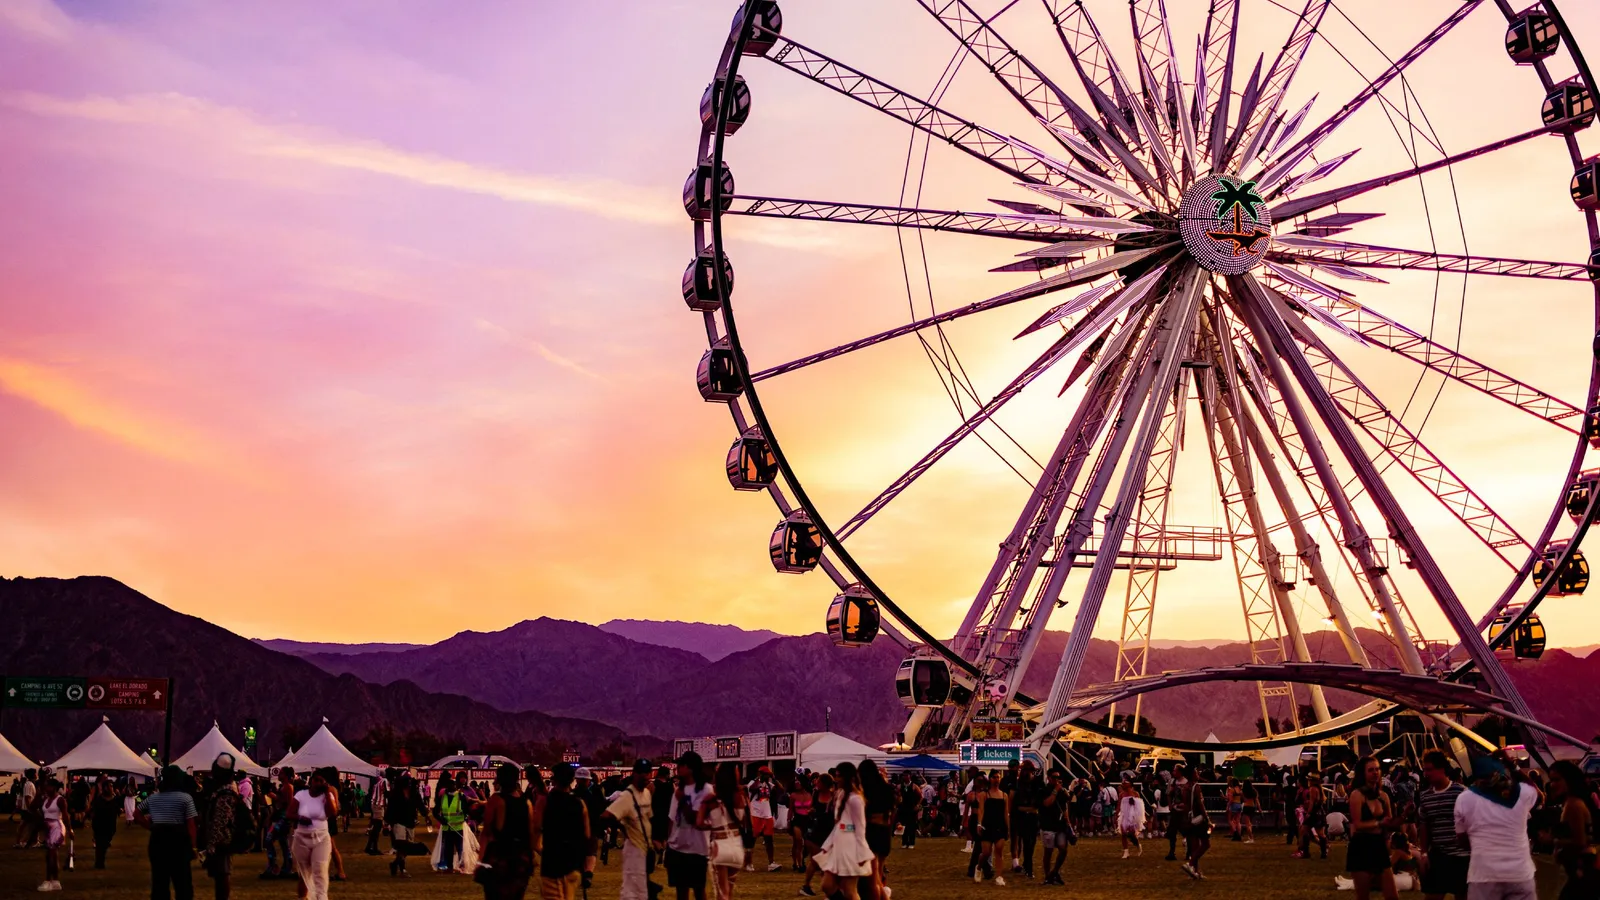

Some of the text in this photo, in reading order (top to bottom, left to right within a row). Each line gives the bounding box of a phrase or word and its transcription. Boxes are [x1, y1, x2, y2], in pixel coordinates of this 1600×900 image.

[770, 737, 775, 755] ID
[776, 736, 791, 754] CHECK
[984, 750, 1012, 758] tickets
